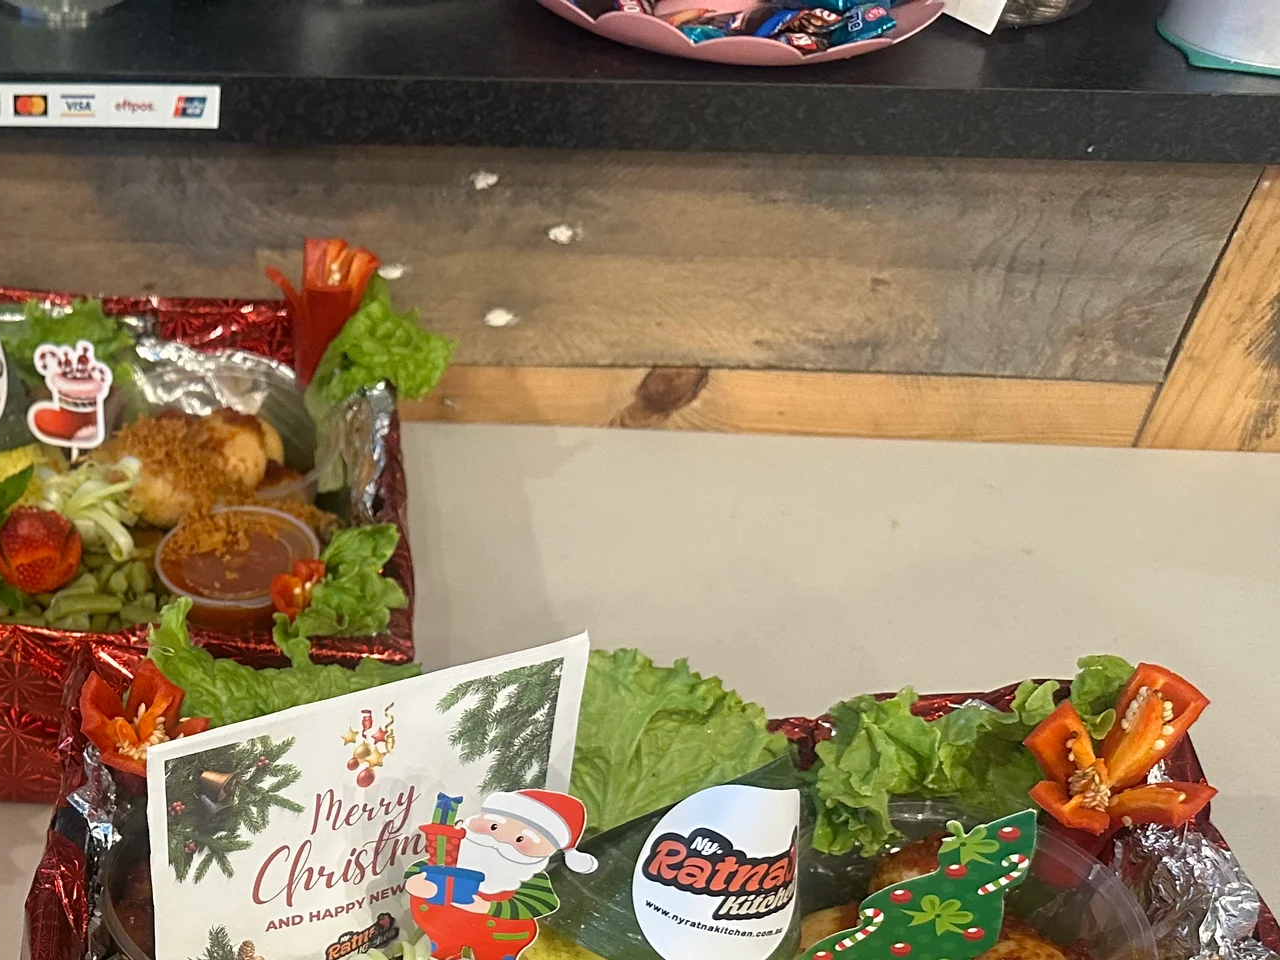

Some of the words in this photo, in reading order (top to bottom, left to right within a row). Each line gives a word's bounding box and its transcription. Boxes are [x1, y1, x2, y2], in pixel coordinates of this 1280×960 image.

[66, 101, 91, 111] VISA
[311, 785, 421, 835] Merry
[252, 820, 430, 907] Christm
[648, 840, 789, 892] Ratna
[265, 914, 304, 932] AND
[309, 897, 365, 922] HAPPY
